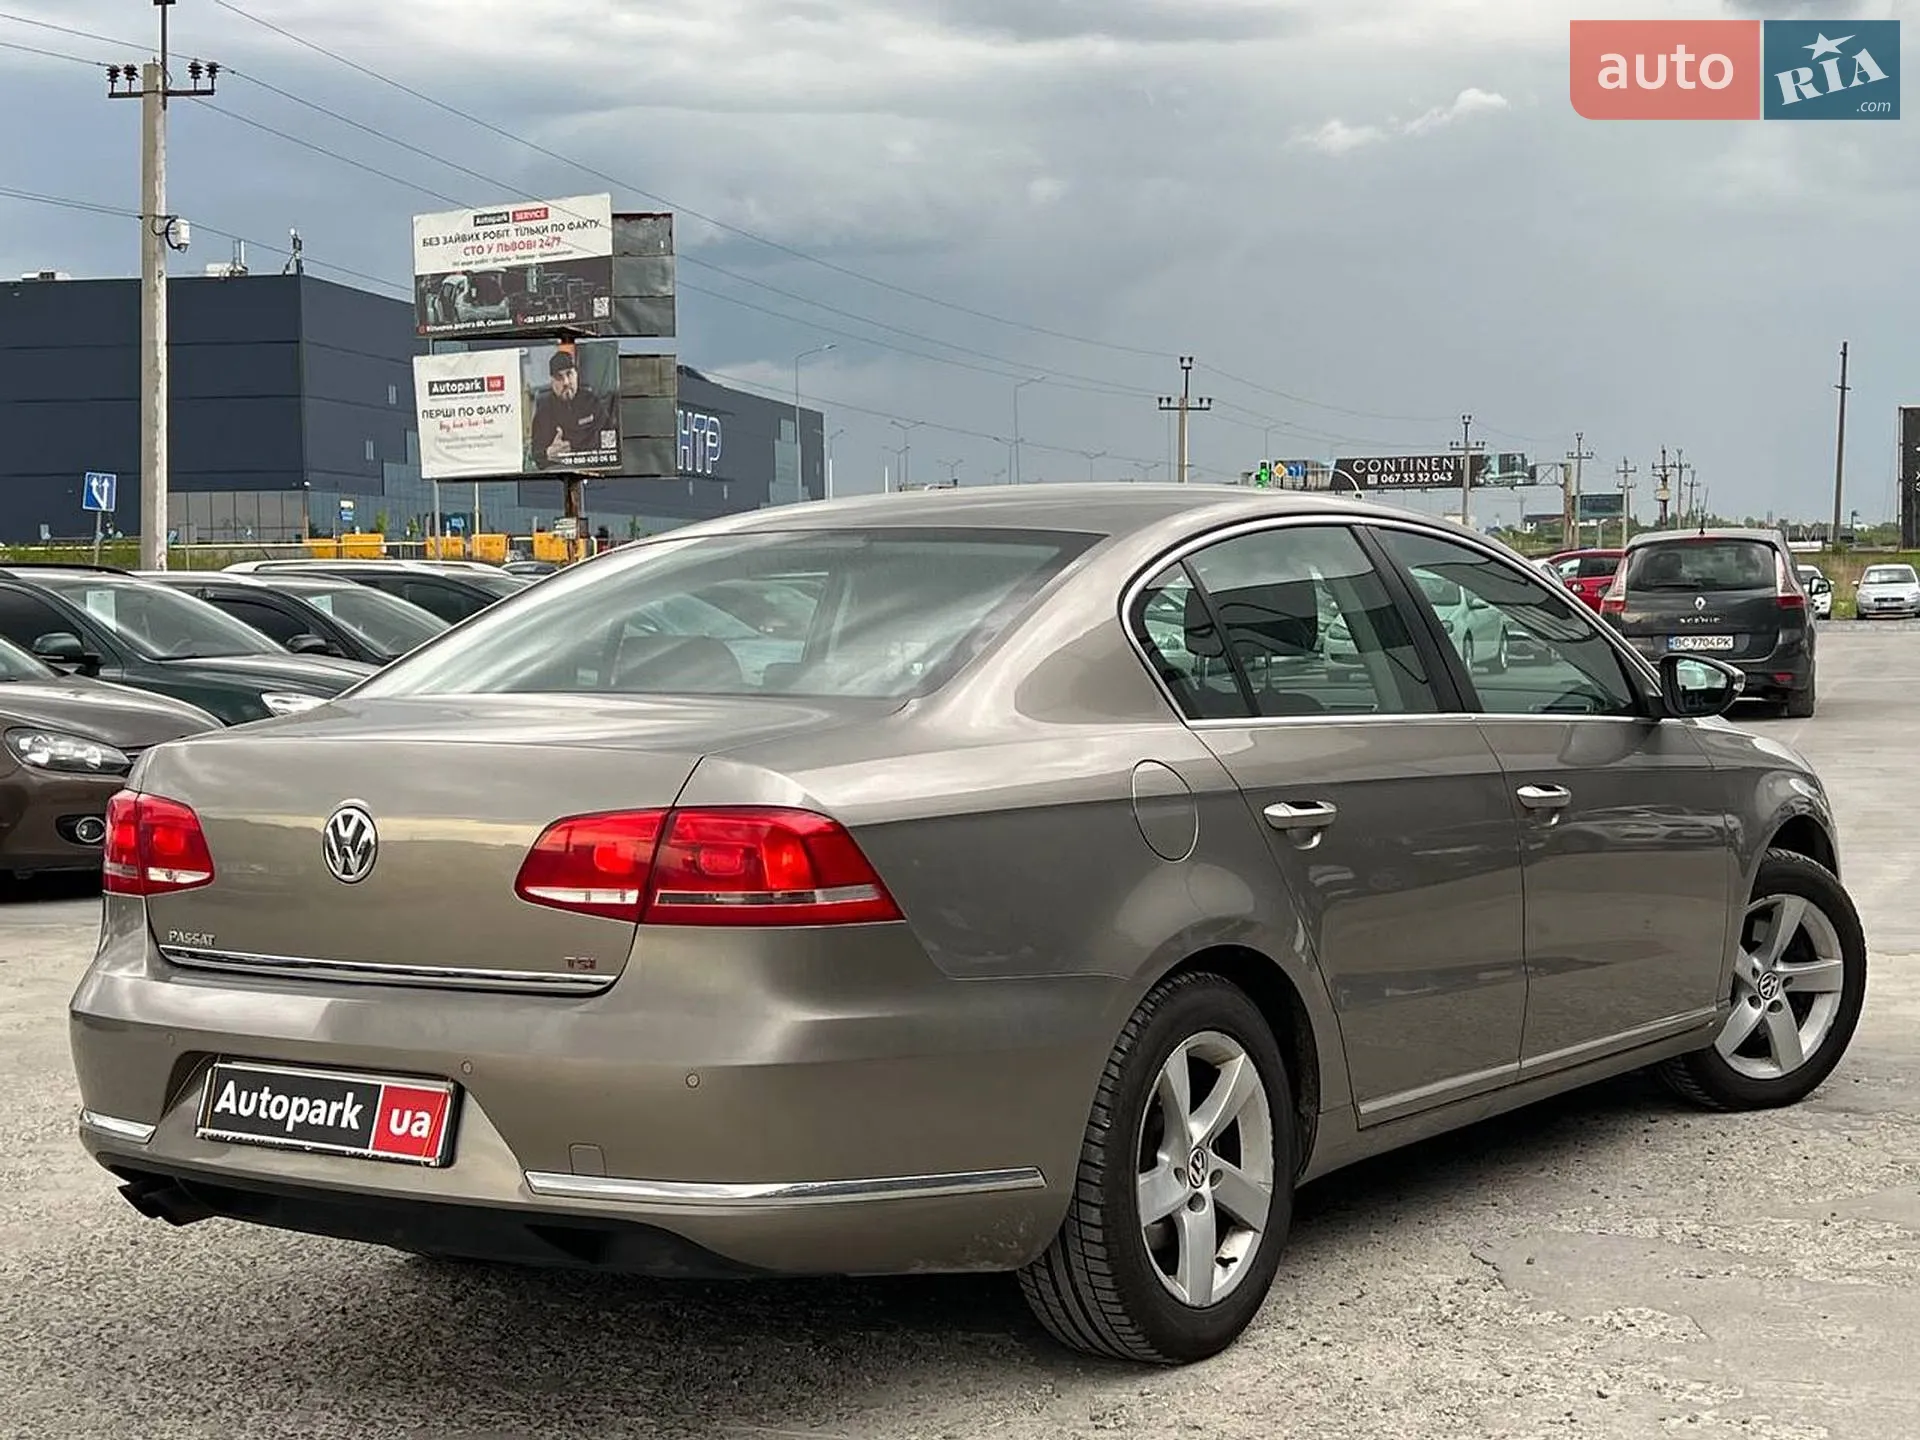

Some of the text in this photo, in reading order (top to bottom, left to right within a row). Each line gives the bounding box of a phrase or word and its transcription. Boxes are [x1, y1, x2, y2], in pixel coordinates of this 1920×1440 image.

[515, 209, 546, 220] SERVICE
[422, 237, 440, 247] БЕЗ
[442, 232, 480, 245] ЗАЙВИХ
[551, 223, 565, 232] ПО
[463, 245, 484, 256] СТО
[487, 243, 493, 254] У
[496, 239, 536, 253] ЛЬВОВІ
[431, 379, 482, 394] Autopark
[421, 409, 456, 419] ПЕРШІ
[458, 407, 474, 417] ПО
[1353, 456, 1465, 473] CONTINENT
[1381, 471, 1453, 483] 067 33 32 043
[168, 930, 216, 946] PASSAT
[564, 956, 597, 970] TSI
[214, 1080, 431, 1138] Autopark ua
